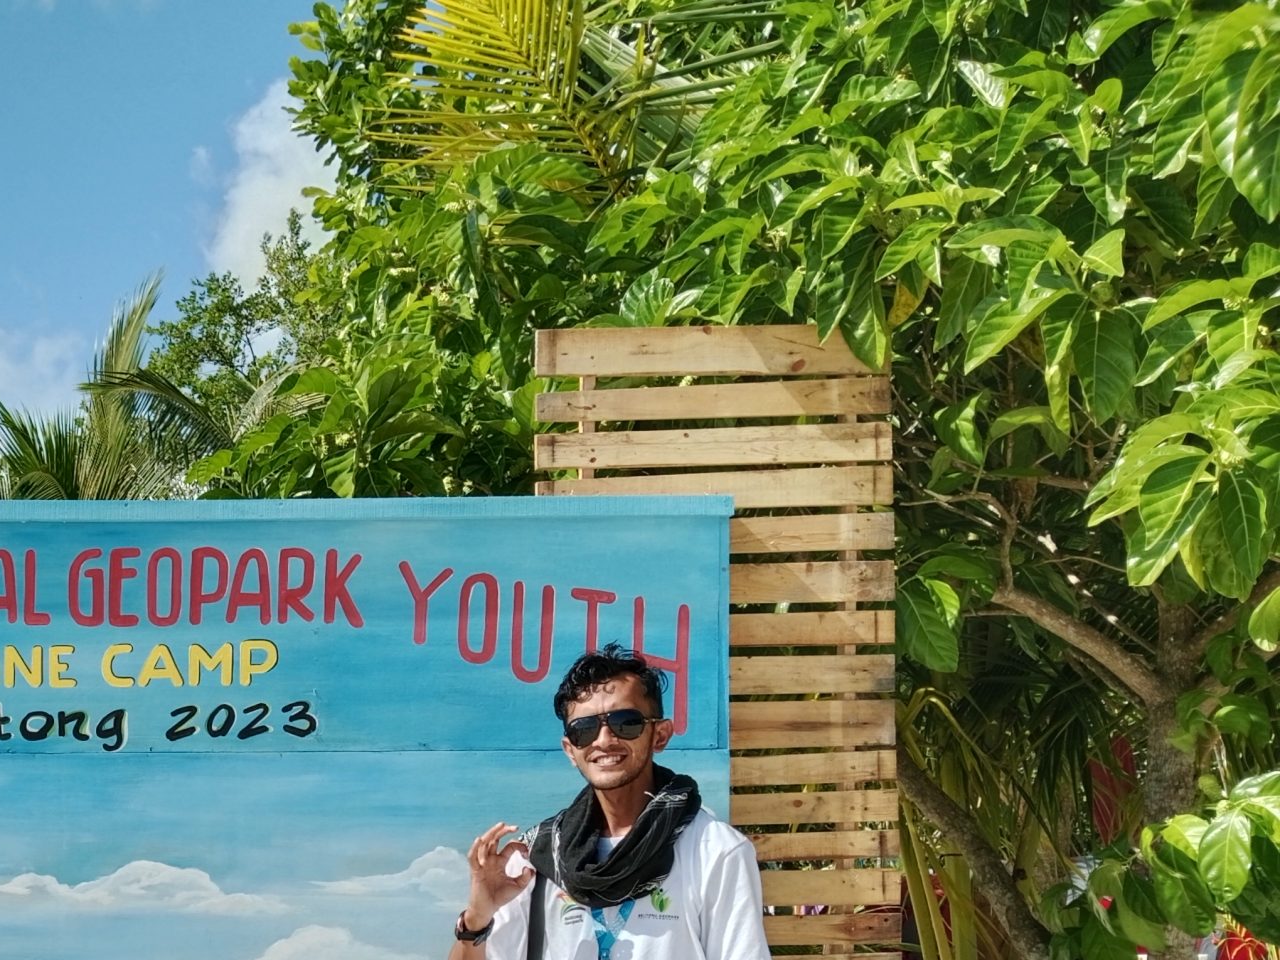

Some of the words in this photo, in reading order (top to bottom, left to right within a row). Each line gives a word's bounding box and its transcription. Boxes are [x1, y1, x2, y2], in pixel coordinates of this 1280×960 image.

[67, 546, 364, 628] GEOPARK
[399, 559, 691, 735] YOUTH
[101, 639, 279, 688] CAMP
[164, 701, 318, 742] 2023
